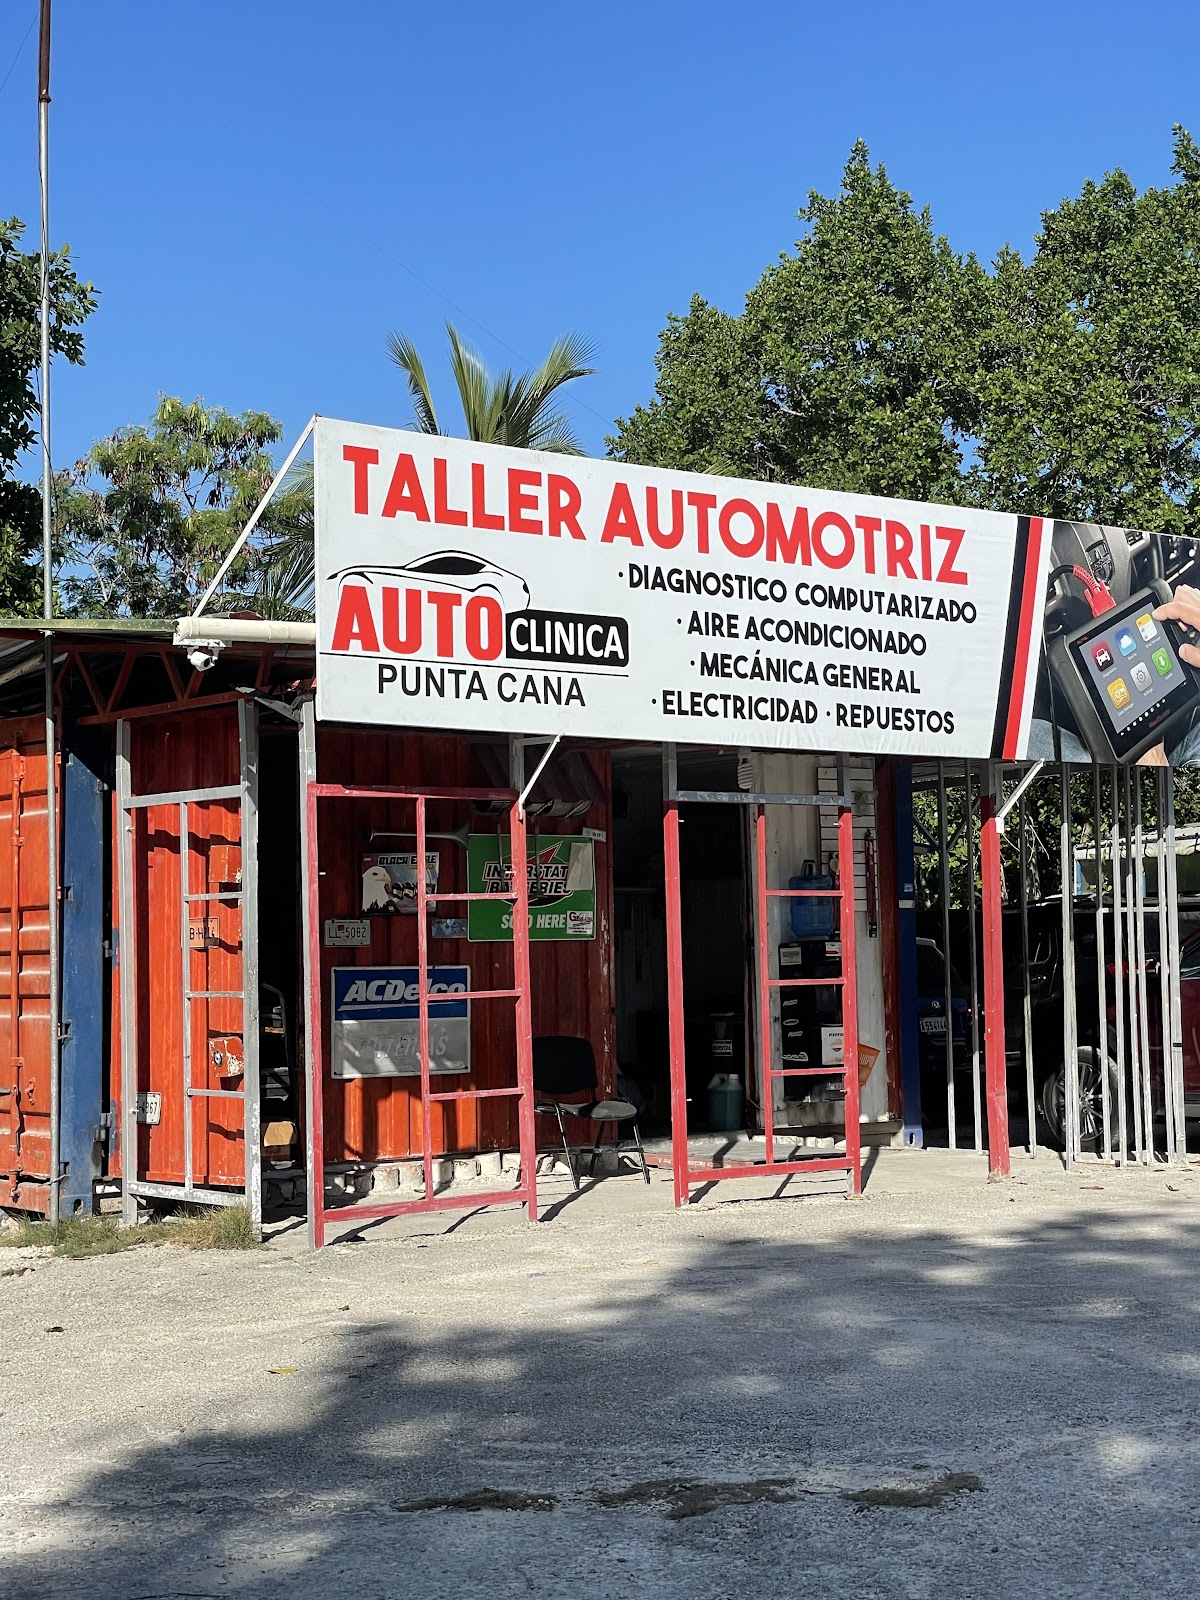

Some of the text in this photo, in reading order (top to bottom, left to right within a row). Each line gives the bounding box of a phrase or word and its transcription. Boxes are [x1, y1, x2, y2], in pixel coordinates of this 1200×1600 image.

[343, 445, 968, 585] TALLER AUTOMOTRIZ
[628, 563, 977, 624] DIAGNOSTICO COMPUTARIZADO
[331, 584, 625, 661] AUTO CLINICA
[687, 611, 926, 656] AIRE ACONDICIONADO
[378, 663, 586, 707] PUNTA CANA
[700, 649, 921, 694] MECÁNICA GENERAL
[662, 690, 954, 735] ELECTRICIDAD REPUESTOS
[378, 856, 408, 866] BLACK
[536, 914, 566, 928] HERE
